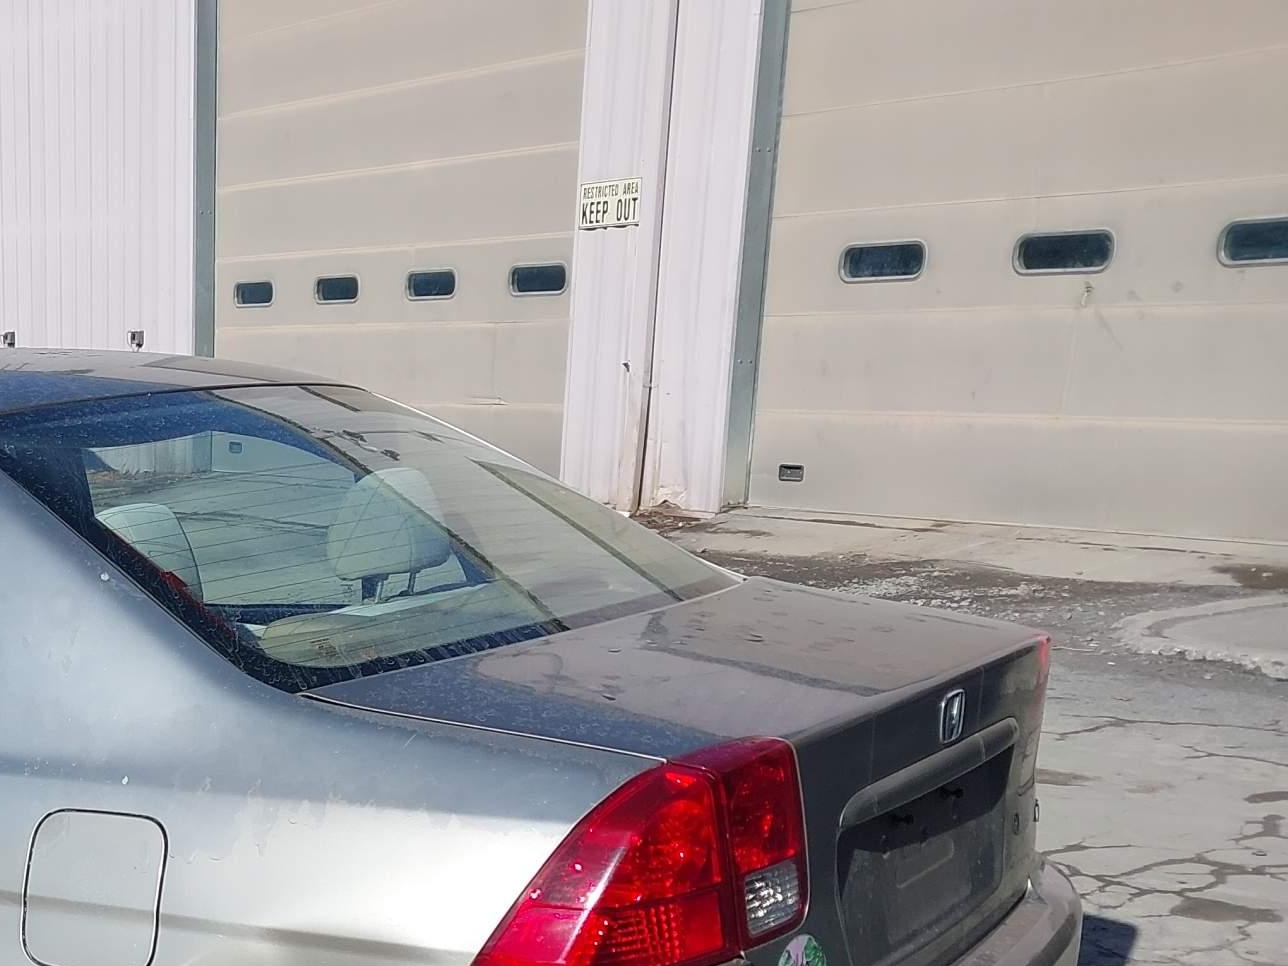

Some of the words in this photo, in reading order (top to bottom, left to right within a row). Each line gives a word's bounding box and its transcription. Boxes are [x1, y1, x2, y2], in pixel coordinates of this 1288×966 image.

[583, 184, 619, 199] RESTRICTED
[622, 182, 639, 195] AREA
[582, 200, 609, 224] KEEP
[616, 197, 638, 221] OUT
